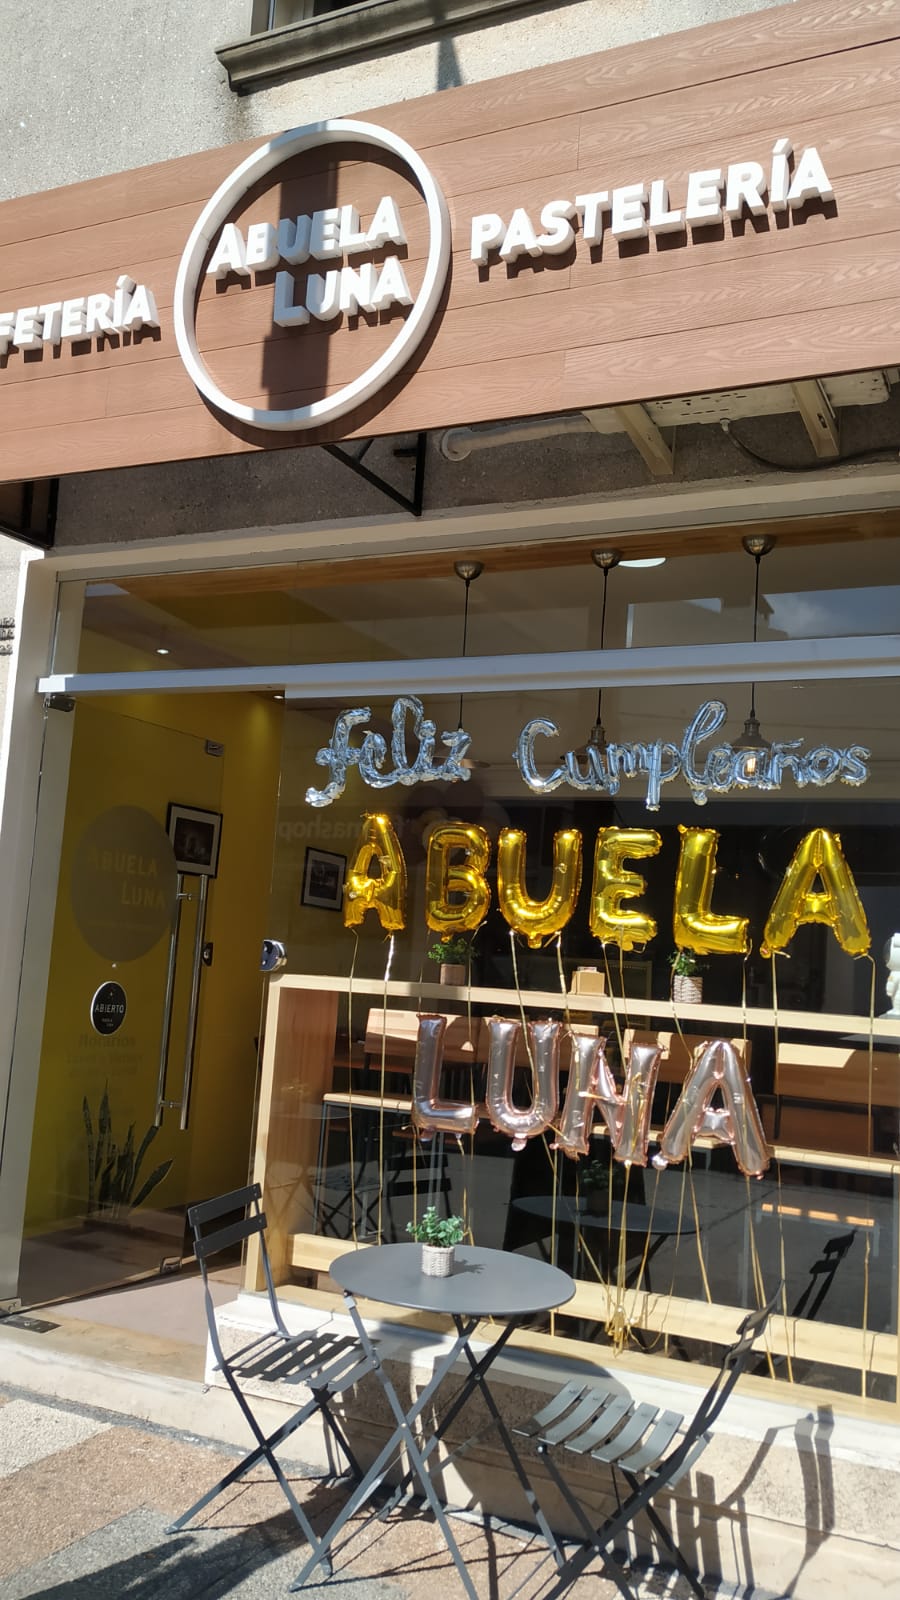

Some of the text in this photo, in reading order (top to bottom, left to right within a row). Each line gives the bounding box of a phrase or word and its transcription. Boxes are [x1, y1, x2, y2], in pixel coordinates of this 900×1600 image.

[206, 196, 407, 279] ABUELA
[470, 138, 834, 266] PASTELERÍA
[273, 255, 415, 328] LUNA
[343, 811, 873, 959] ABUELA
[94, 1003, 125, 1014] ABIERTO
[411, 1013, 772, 1180] LUNA
